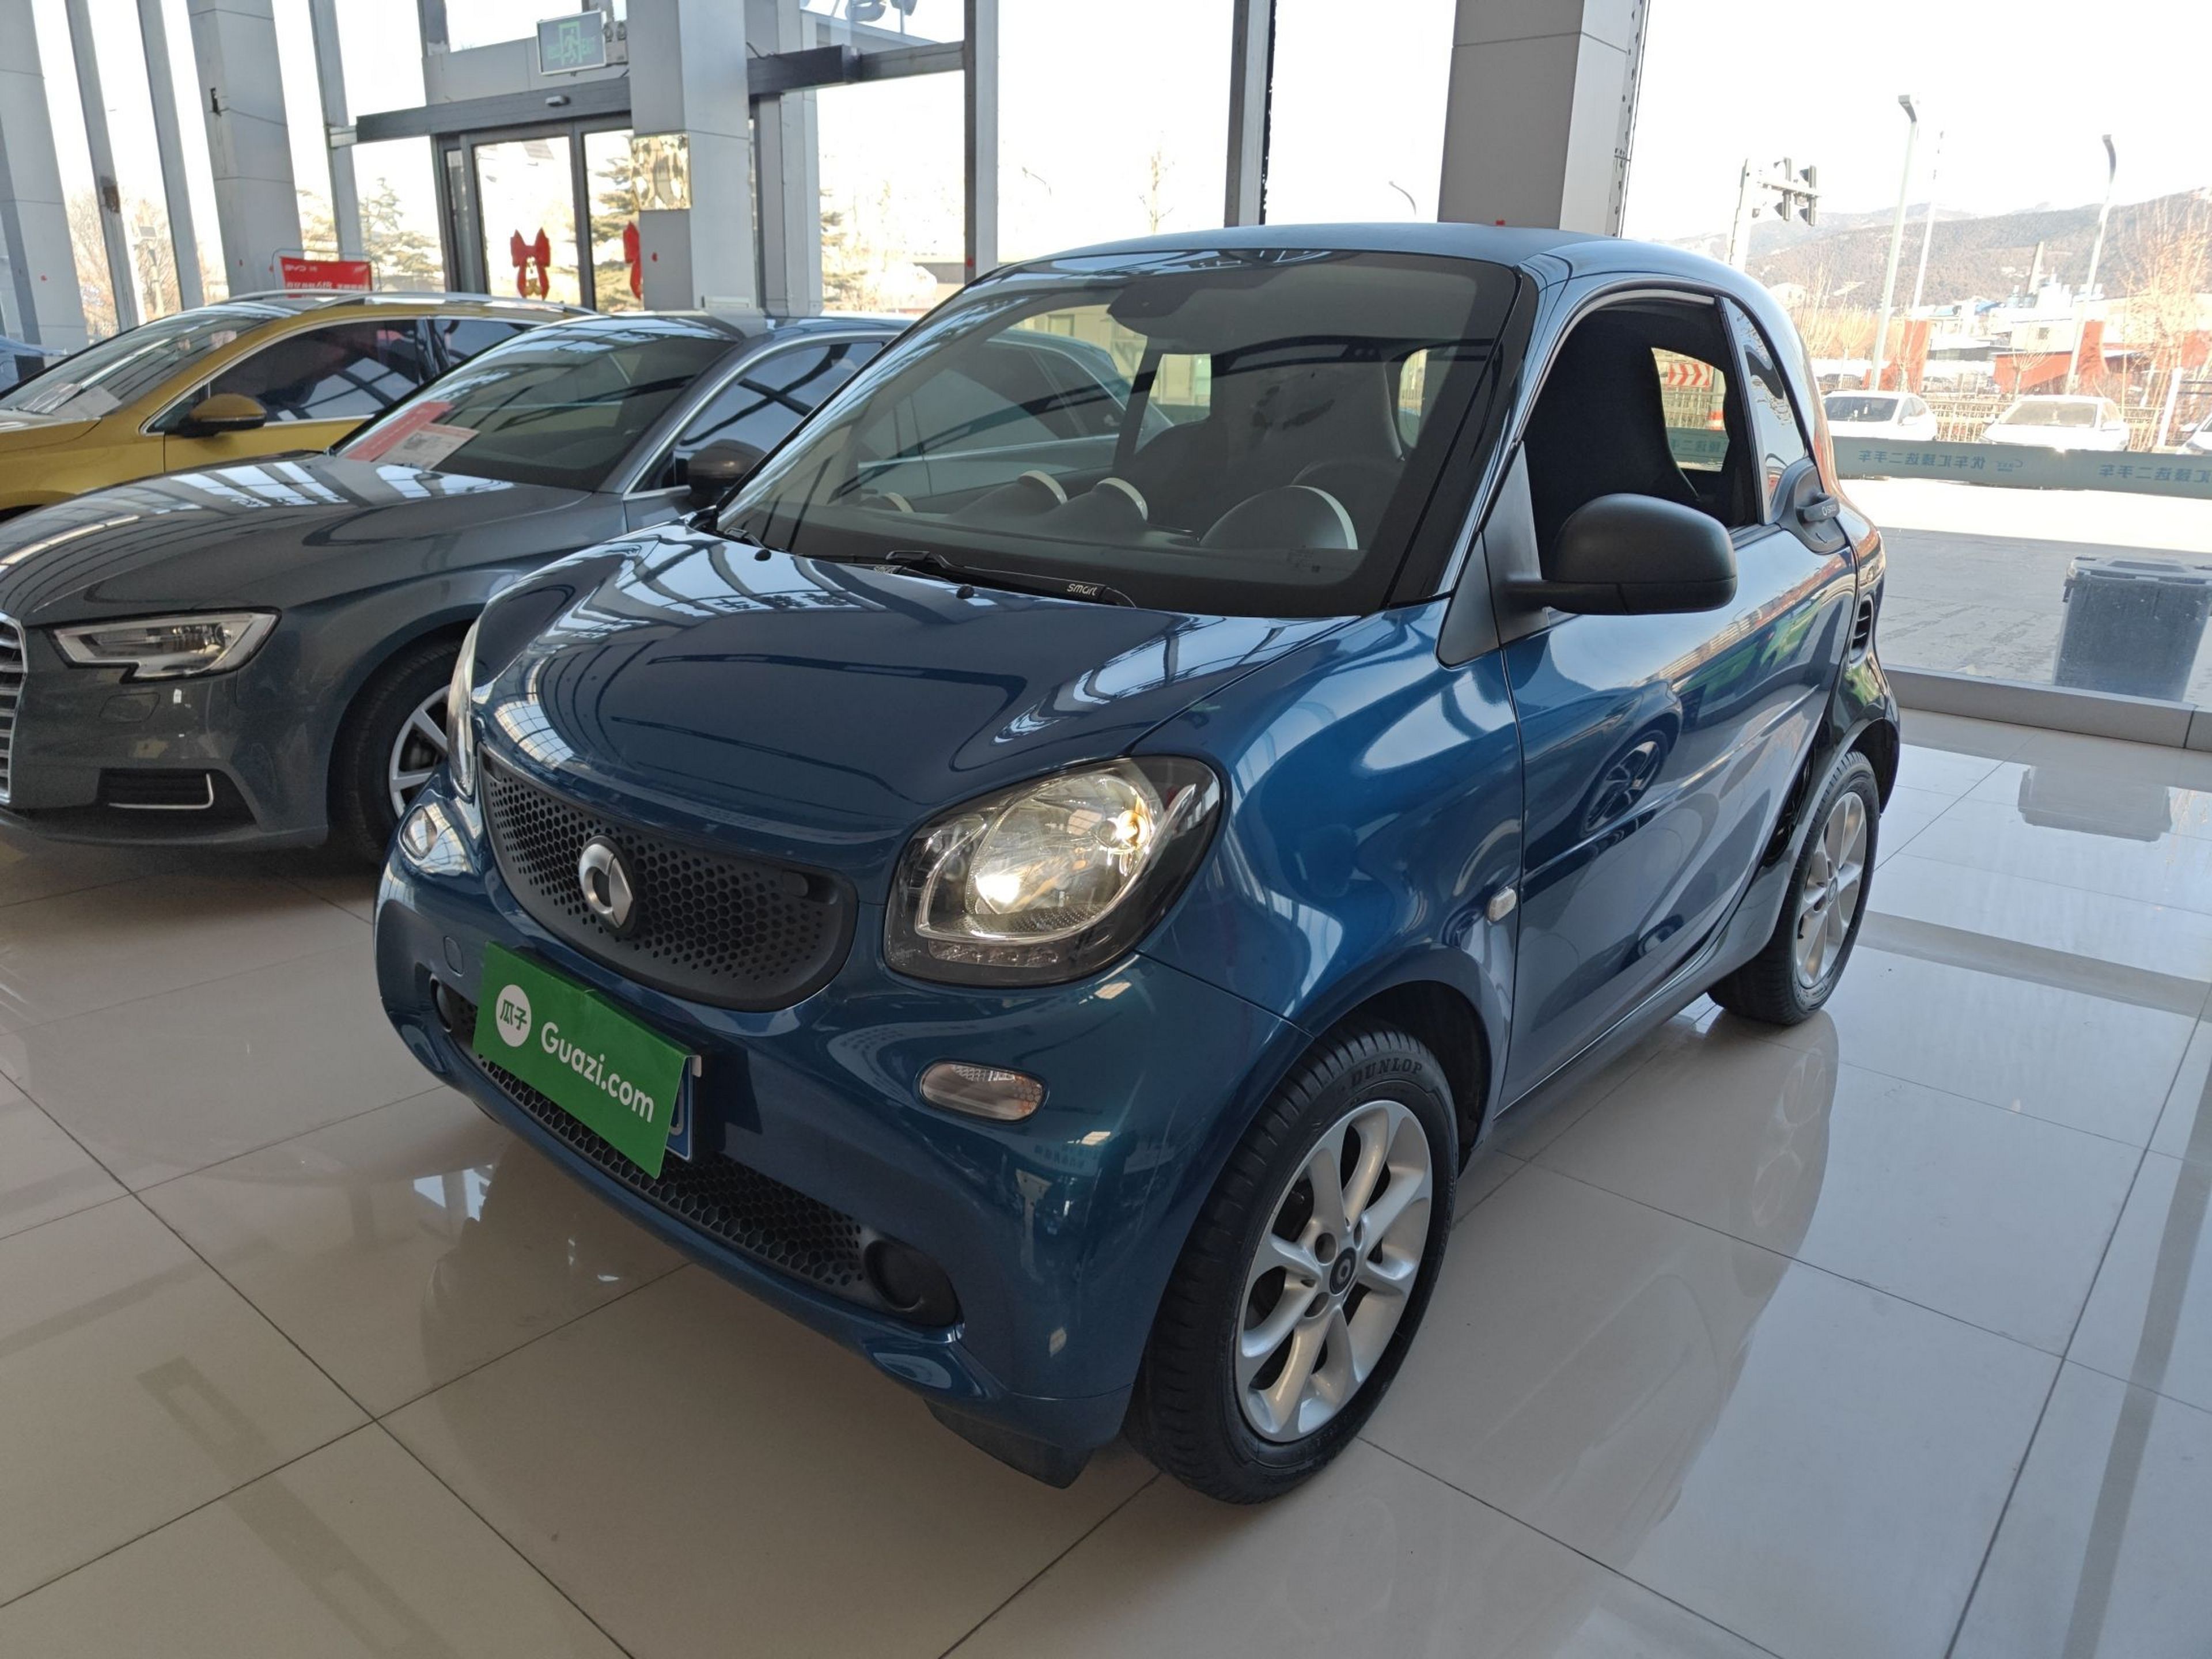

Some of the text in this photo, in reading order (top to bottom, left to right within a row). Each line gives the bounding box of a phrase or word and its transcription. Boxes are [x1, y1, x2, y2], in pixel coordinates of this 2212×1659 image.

[1067, 583, 1097, 596] smart
[500, 999, 528, 1031] 瓜子
[541, 1021, 654, 1123] Guazi.com
[1351, 1057, 1423, 1088] DUNLOP
